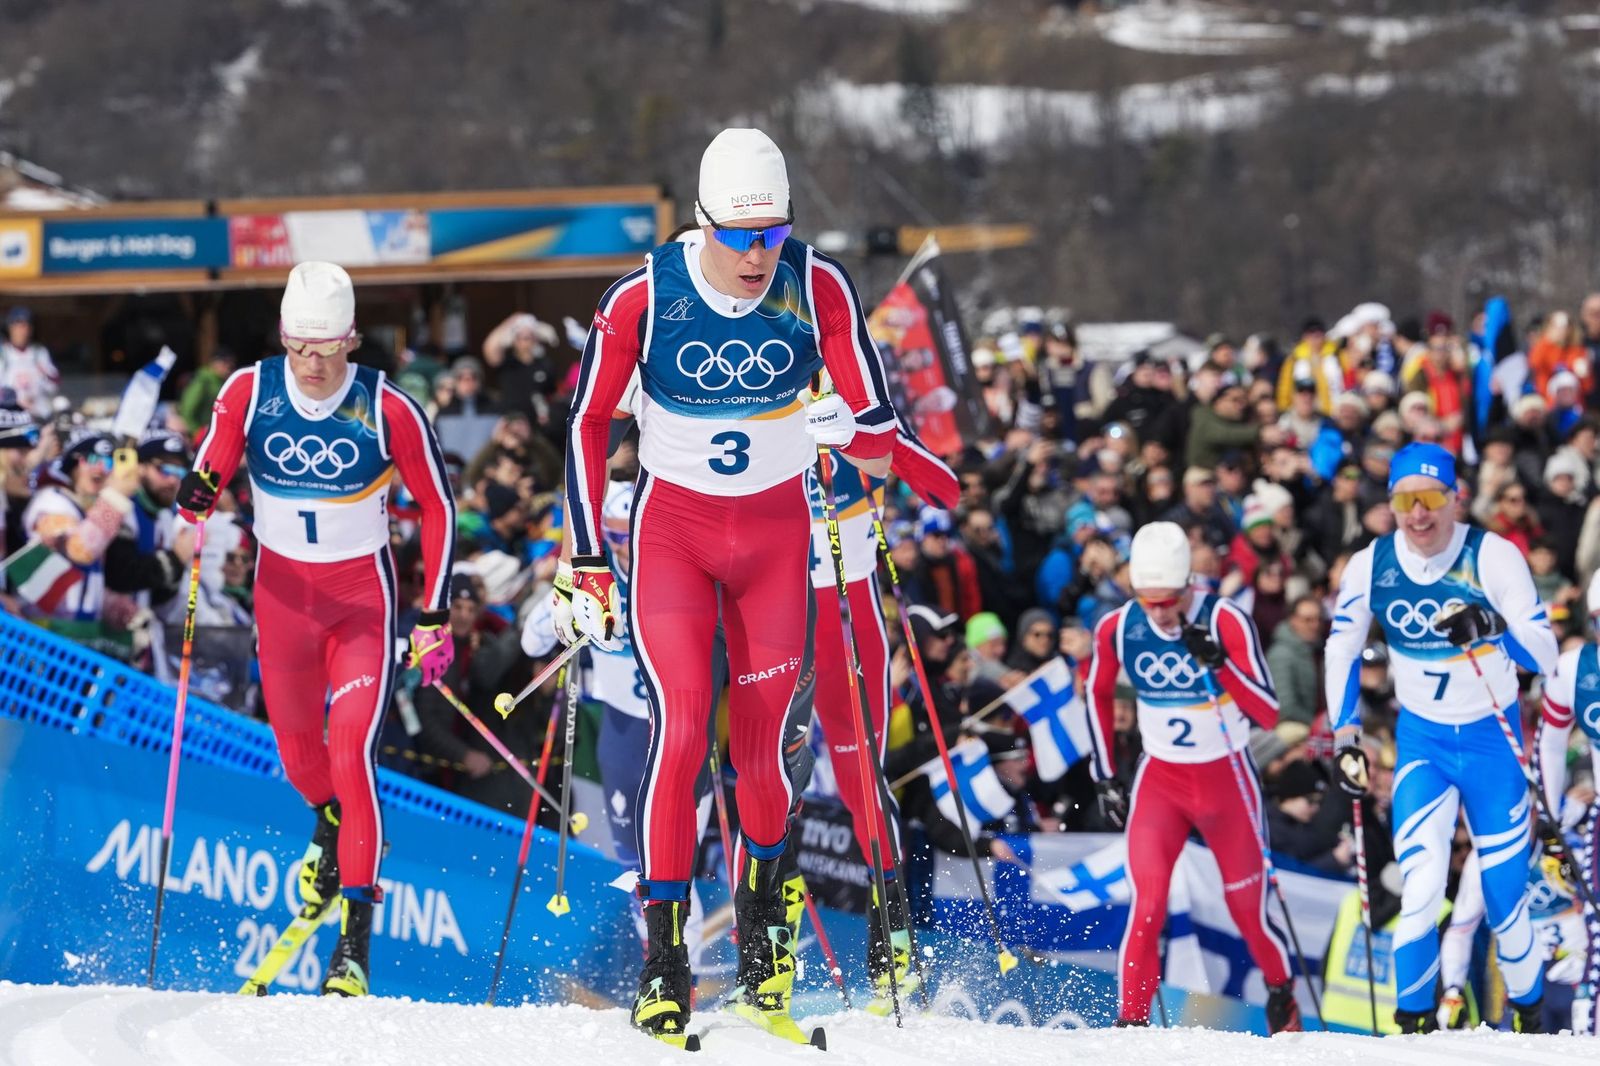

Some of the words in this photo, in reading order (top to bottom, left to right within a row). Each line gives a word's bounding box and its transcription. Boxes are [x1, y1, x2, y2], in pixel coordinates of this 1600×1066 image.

[731, 193, 773, 204] NORGE
[671, 395, 720, 405] MILANO
[722, 396, 773, 405] CORTINA
[776, 387, 796, 400] 2026
[708, 431, 751, 476] 3
[298, 510, 318, 544] 1
[738, 663, 788, 686] CRAFT
[1423, 670, 1450, 701] 7
[1167, 717, 1197, 748] 2
[85, 818, 280, 912] MILANO
[284, 858, 470, 957] CTINA
